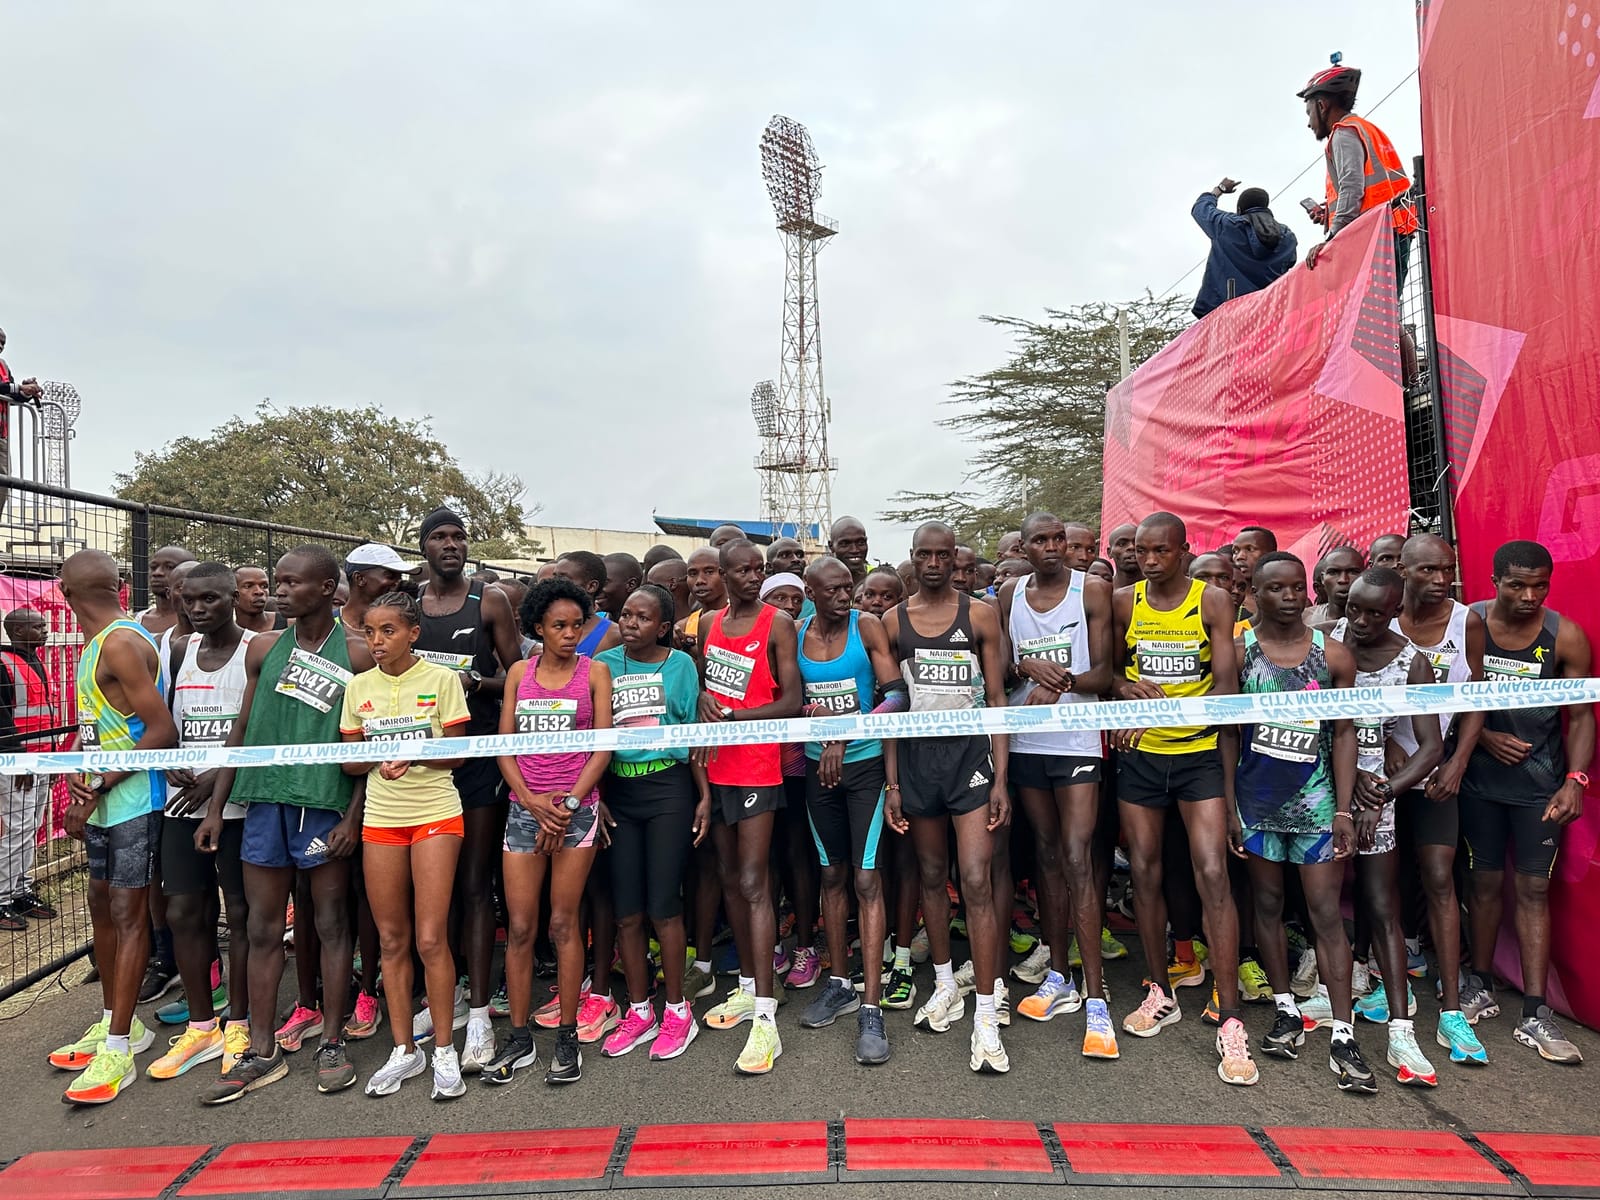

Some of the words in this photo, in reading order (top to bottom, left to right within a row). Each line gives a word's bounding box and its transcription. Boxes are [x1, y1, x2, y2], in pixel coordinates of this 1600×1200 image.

[308, 655, 340, 673] NAIROBI
[426, 652, 458, 662] NAIROBI
[717, 649, 742, 662] NAIROBI
[1142, 655, 1195, 672] 20056
[1488, 657, 1524, 668] NAIROBI
[617, 674, 648, 684] NAIROBI
[705, 660, 746, 686] 20452
[919, 664, 968, 681] 23810
[287, 665, 338, 698] 20471
[815, 682, 842, 690] NAIROBI
[612, 686, 660, 710] 23629
[191, 705, 223, 713] NAIROBI
[184, 719, 233, 737] 20744
[379, 716, 413, 726] NAIROBI
[519, 714, 571, 732] 21532
[1258, 725, 1315, 749] 21477
